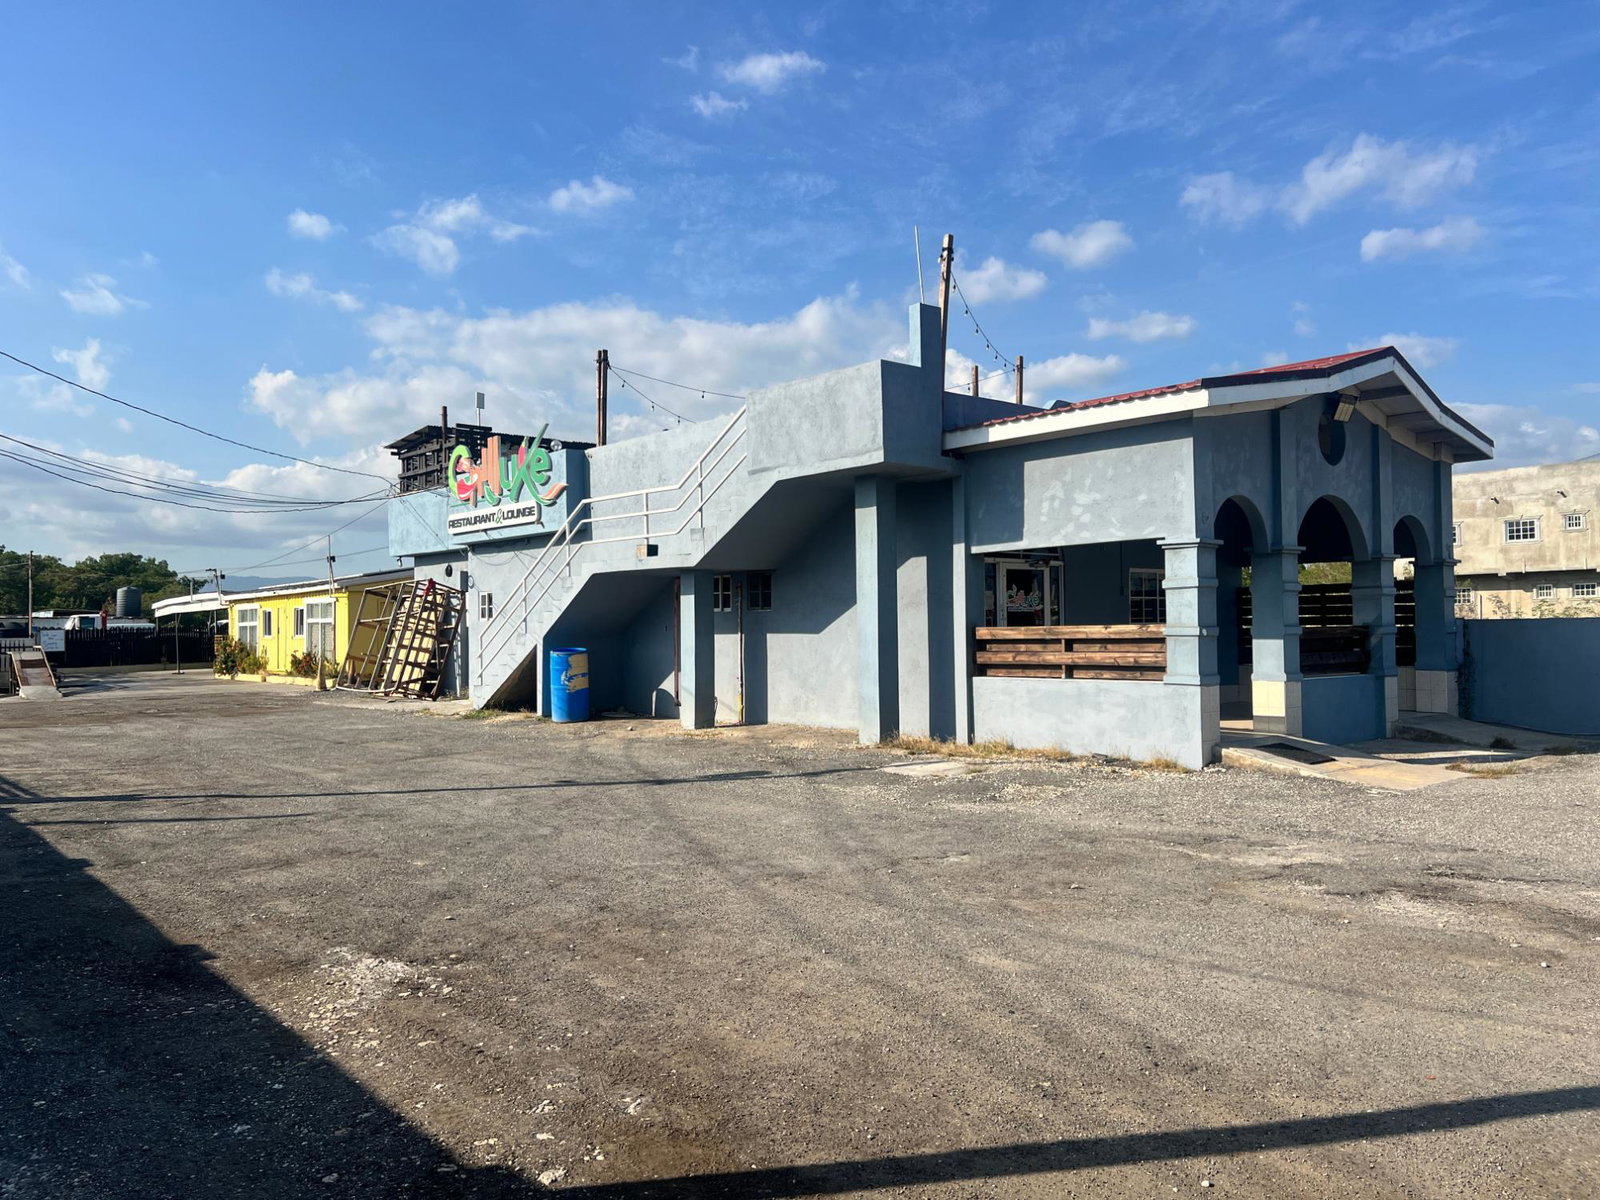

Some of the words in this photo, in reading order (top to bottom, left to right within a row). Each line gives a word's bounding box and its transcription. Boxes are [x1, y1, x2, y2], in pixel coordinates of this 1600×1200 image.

[448, 512, 496, 529] RESTAURANT
[495, 509, 503, 524] &
[502, 505, 535, 519] LOUNGE
